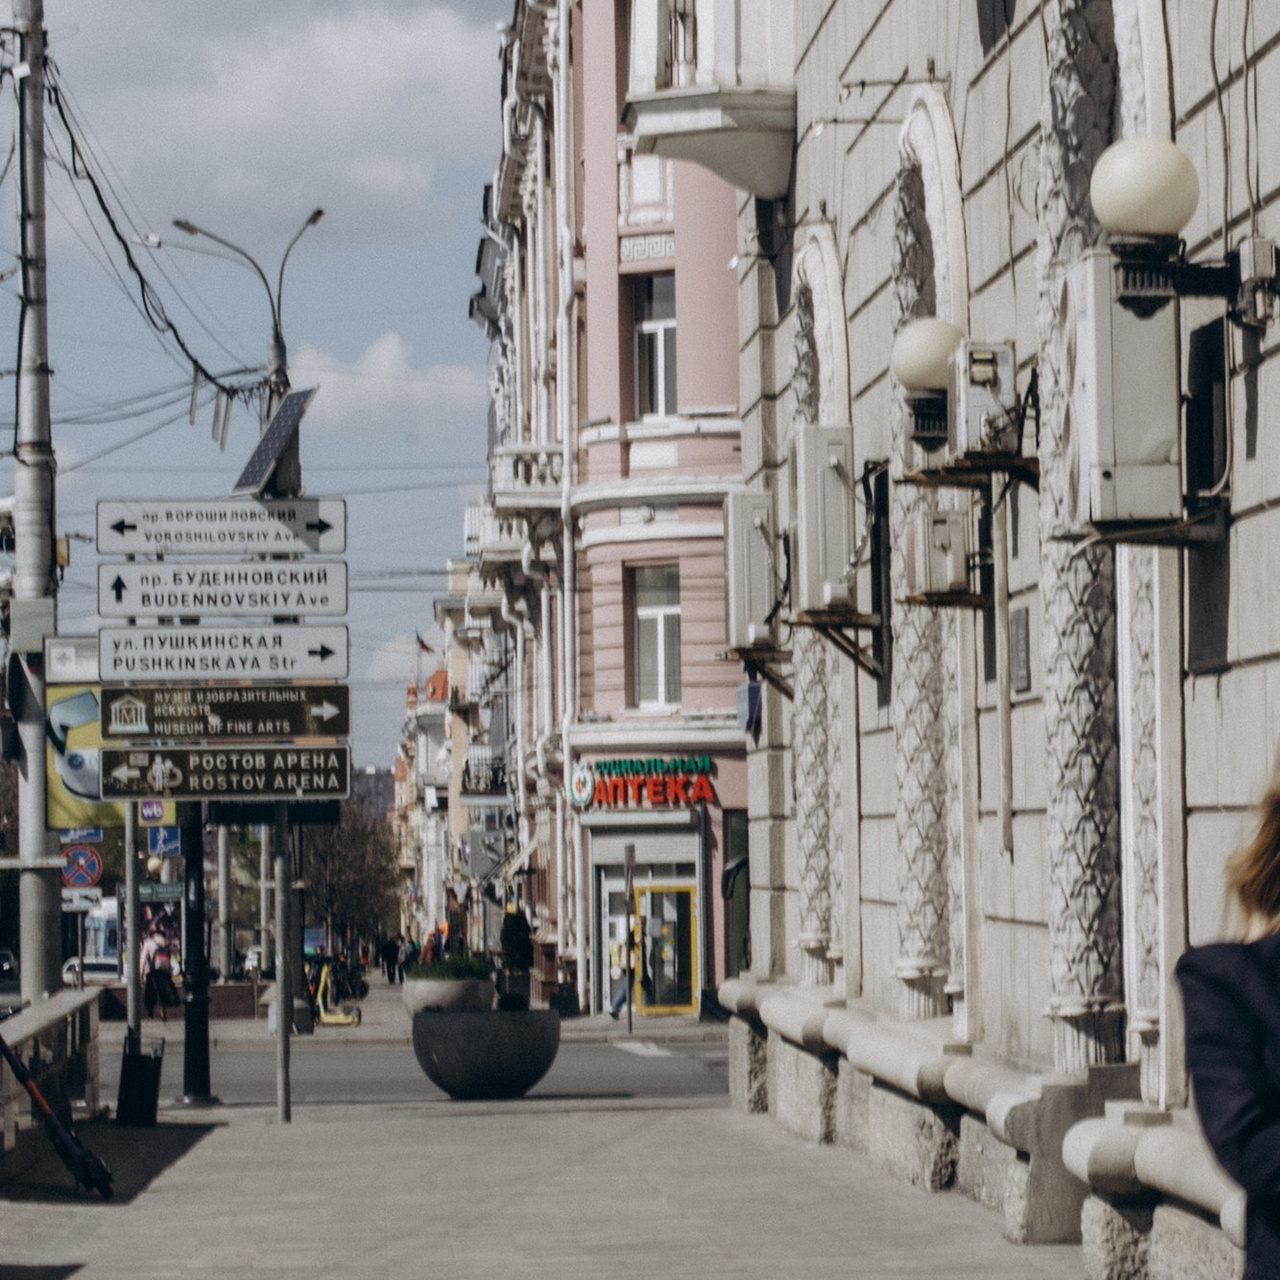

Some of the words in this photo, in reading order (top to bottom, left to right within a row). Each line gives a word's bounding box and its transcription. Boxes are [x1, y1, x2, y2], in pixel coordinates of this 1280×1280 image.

[142, 509, 163, 525] пр.
[165, 508, 297, 521] ВОРОШИЛОВСКИЙ
[145, 531, 269, 543] VOROSHILOVSKIY
[275, 531, 300, 542] Ave
[140, 573, 168, 589] пр.
[173, 569, 328, 587] БУДЕННОВСКИЙ
[142, 593, 290, 607] BUDENNOVSKIY
[296, 593, 330, 607] Ave
[113, 637, 139, 651] ул.
[143, 635, 282, 650] ПУШКИНСКАЯ
[113, 656, 260, 671] PUSHKINSKAYA
[269, 656, 296, 670] Str
[154, 690, 193, 703] МУЗЕЙ
[196, 689, 307, 703] ИЗОБРАЗИТЕЛЬНЫХ
[154, 704, 211, 717] ИСКУССТВ
[154, 721, 204, 735] MUSEUM
[208, 721, 224, 735] OF
[227, 721, 253, 734] FINE
[257, 721, 291, 734] ARTS
[189, 753, 266, 770] РОСТОВ
[273, 752, 340, 769] АРЕНА
[189, 773, 266, 791] ROSTOV
[273, 773, 340, 790] ARENA
[593, 774, 713, 803] АПТЕКА
